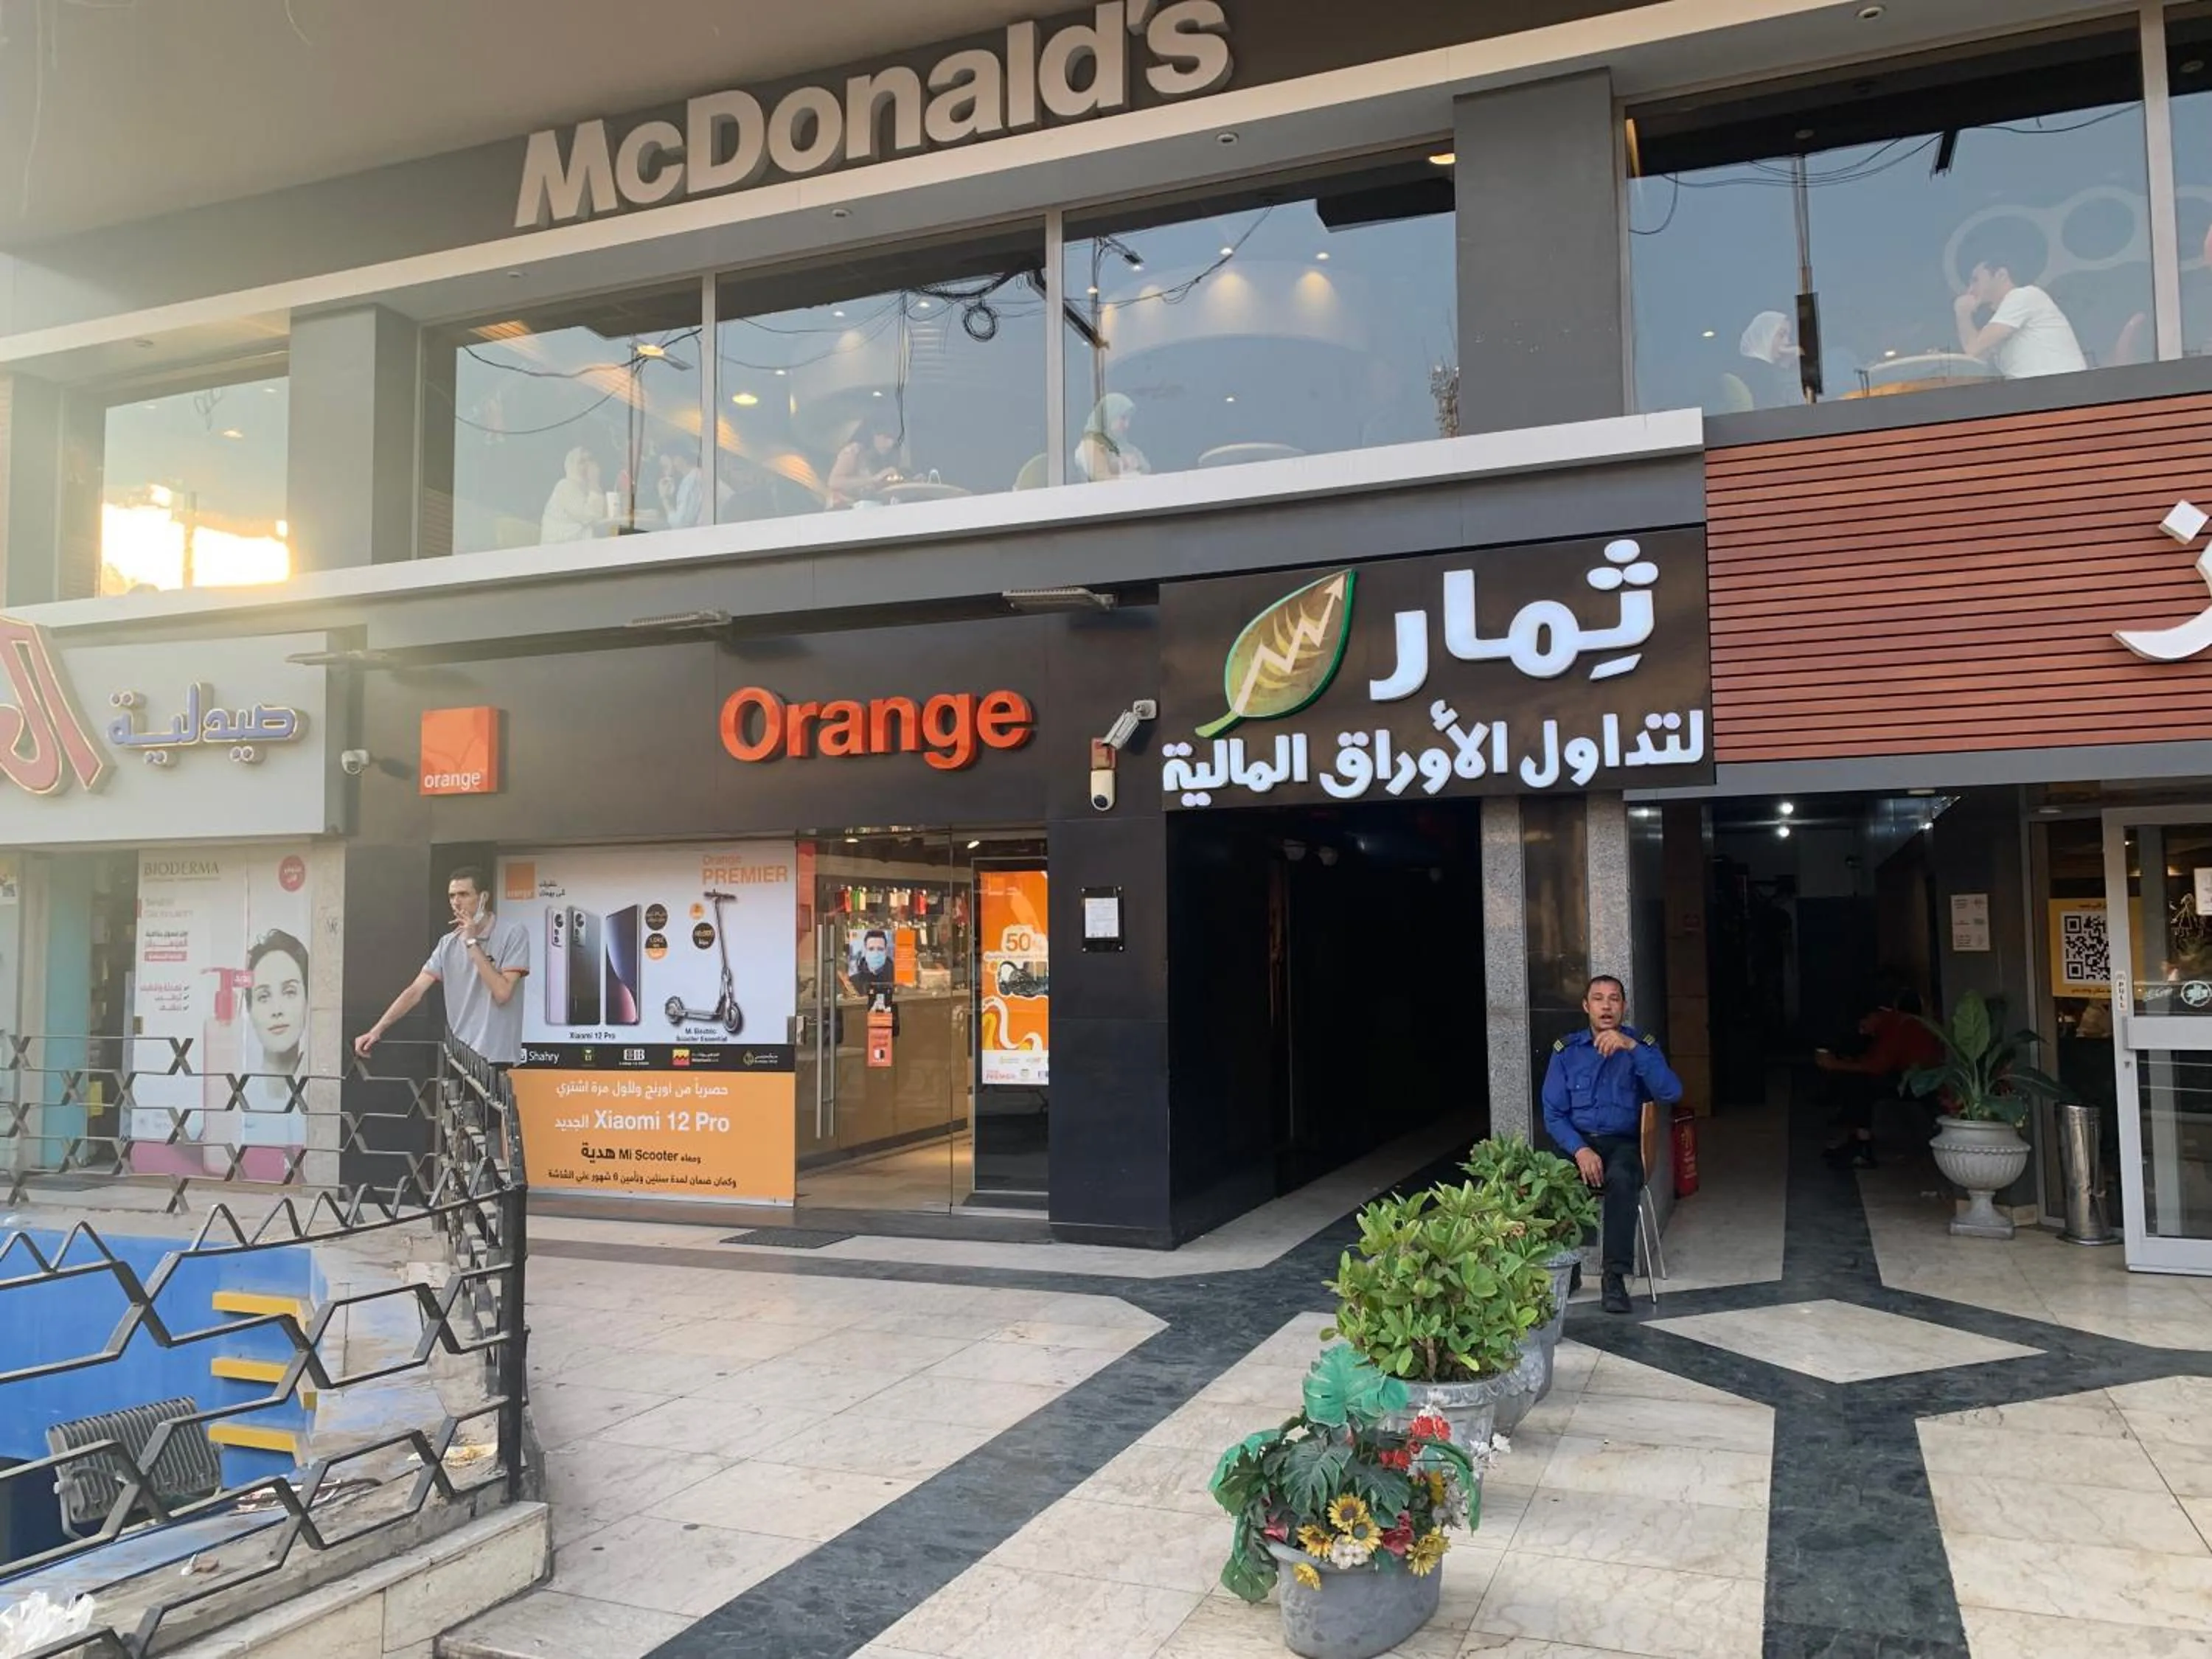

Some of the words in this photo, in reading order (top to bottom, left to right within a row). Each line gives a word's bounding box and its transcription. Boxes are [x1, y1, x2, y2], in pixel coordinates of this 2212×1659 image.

[514, 0, 1233, 229] McDonald's
[106, 682, 299, 765] صيدلية
[720, 686, 1034, 770] Orange
[1320, 700, 1509, 799] الأوراق
[1520, 709, 1705, 788] لتداول
[424, 770, 481, 790] orange
[1162, 733, 1309, 807] المالية
[144, 860, 220, 876] BIODERMA
[702, 865, 787, 885] PREMIER
[1005, 932, 1031, 952] 50
[594, 1032, 602, 1040] 12
[604, 1032, 616, 1040] Pro
[529, 1051, 560, 1064] Shahry
[591, 1081, 609, 1097] مرة
[675, 1083, 692, 1098] من
[554, 1114, 589, 1132] الجديد
[594, 1108, 661, 1131] Xiaomi
[667, 1110, 690, 1131] 12
[695, 1112, 730, 1133] Pro
[580, 1141, 616, 1164] هدية
[635, 1149, 679, 1163] Scooter
